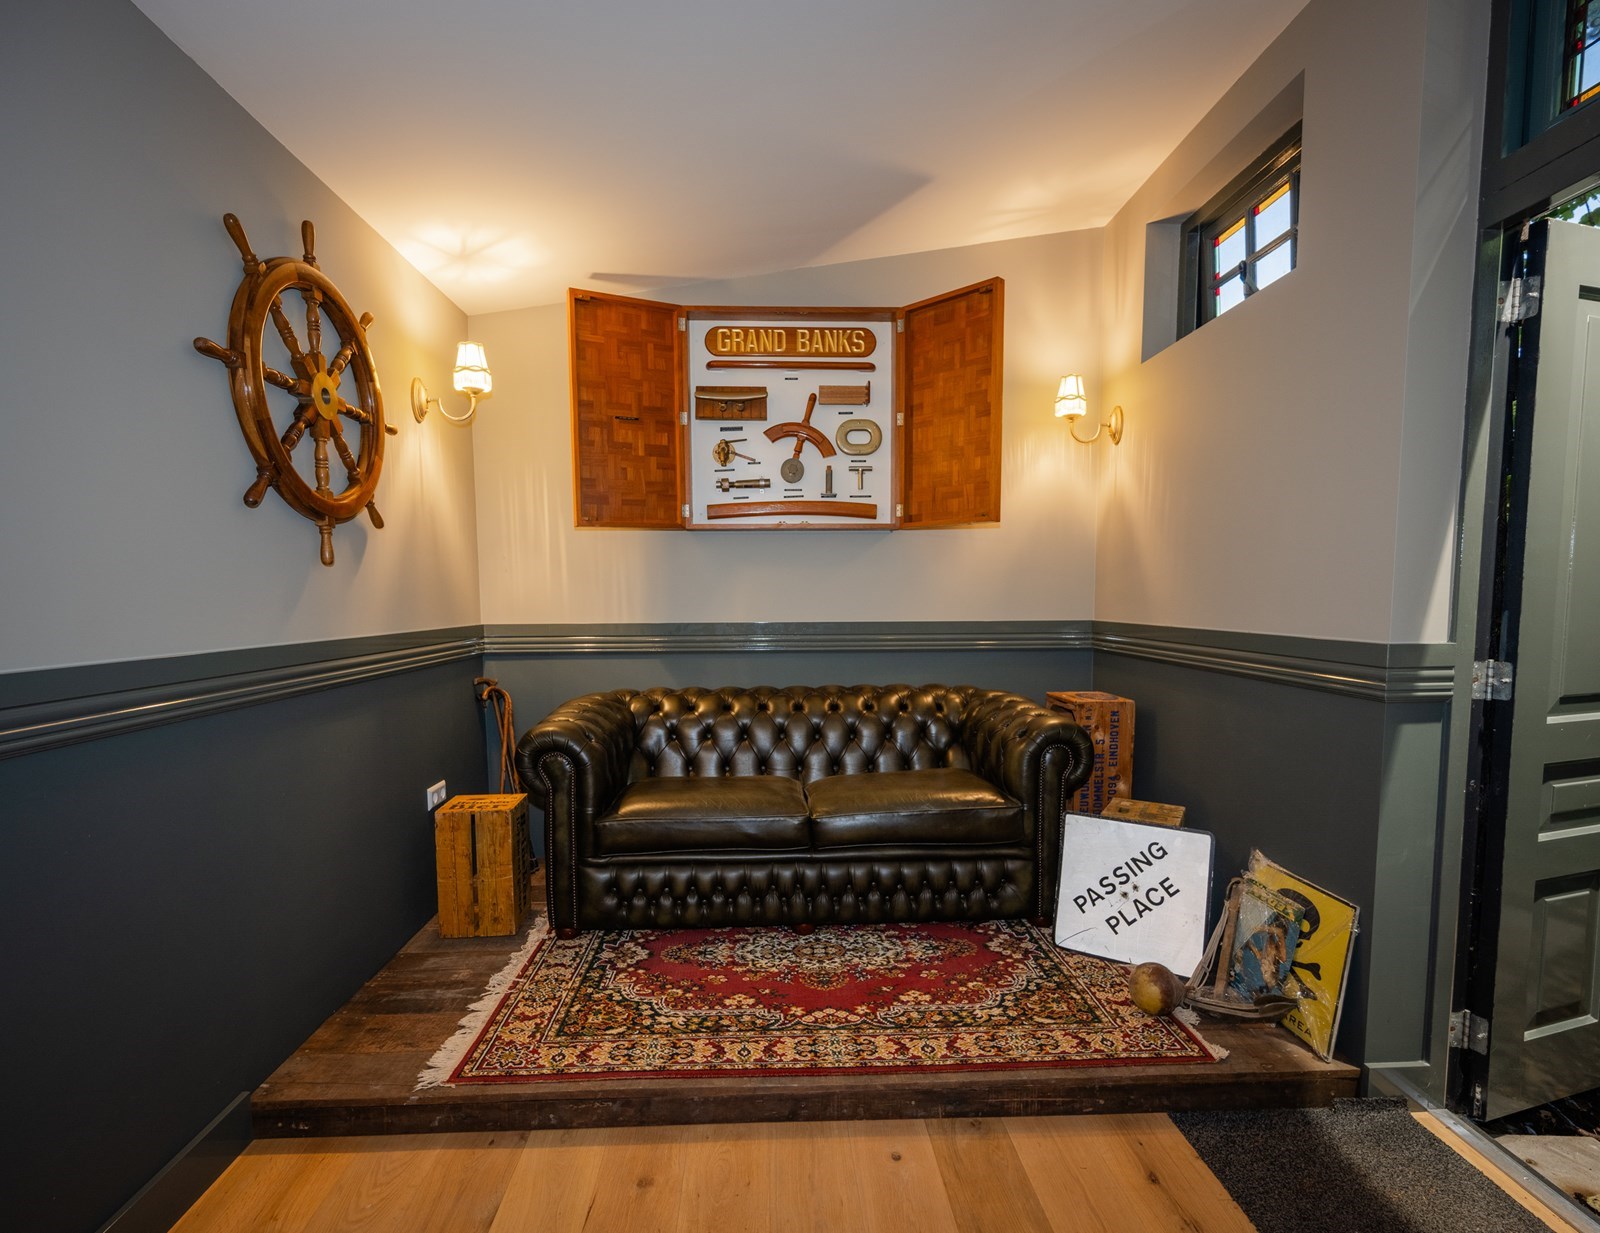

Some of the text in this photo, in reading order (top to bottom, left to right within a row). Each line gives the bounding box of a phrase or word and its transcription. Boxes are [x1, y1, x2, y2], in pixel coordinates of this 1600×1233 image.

[716, 328, 865, 353] GRAND BANKS
[1108, 710, 1119, 766] EINDHOVEN
[1074, 841, 1168, 915] PASSING
[1106, 878, 1181, 936] PLACE
